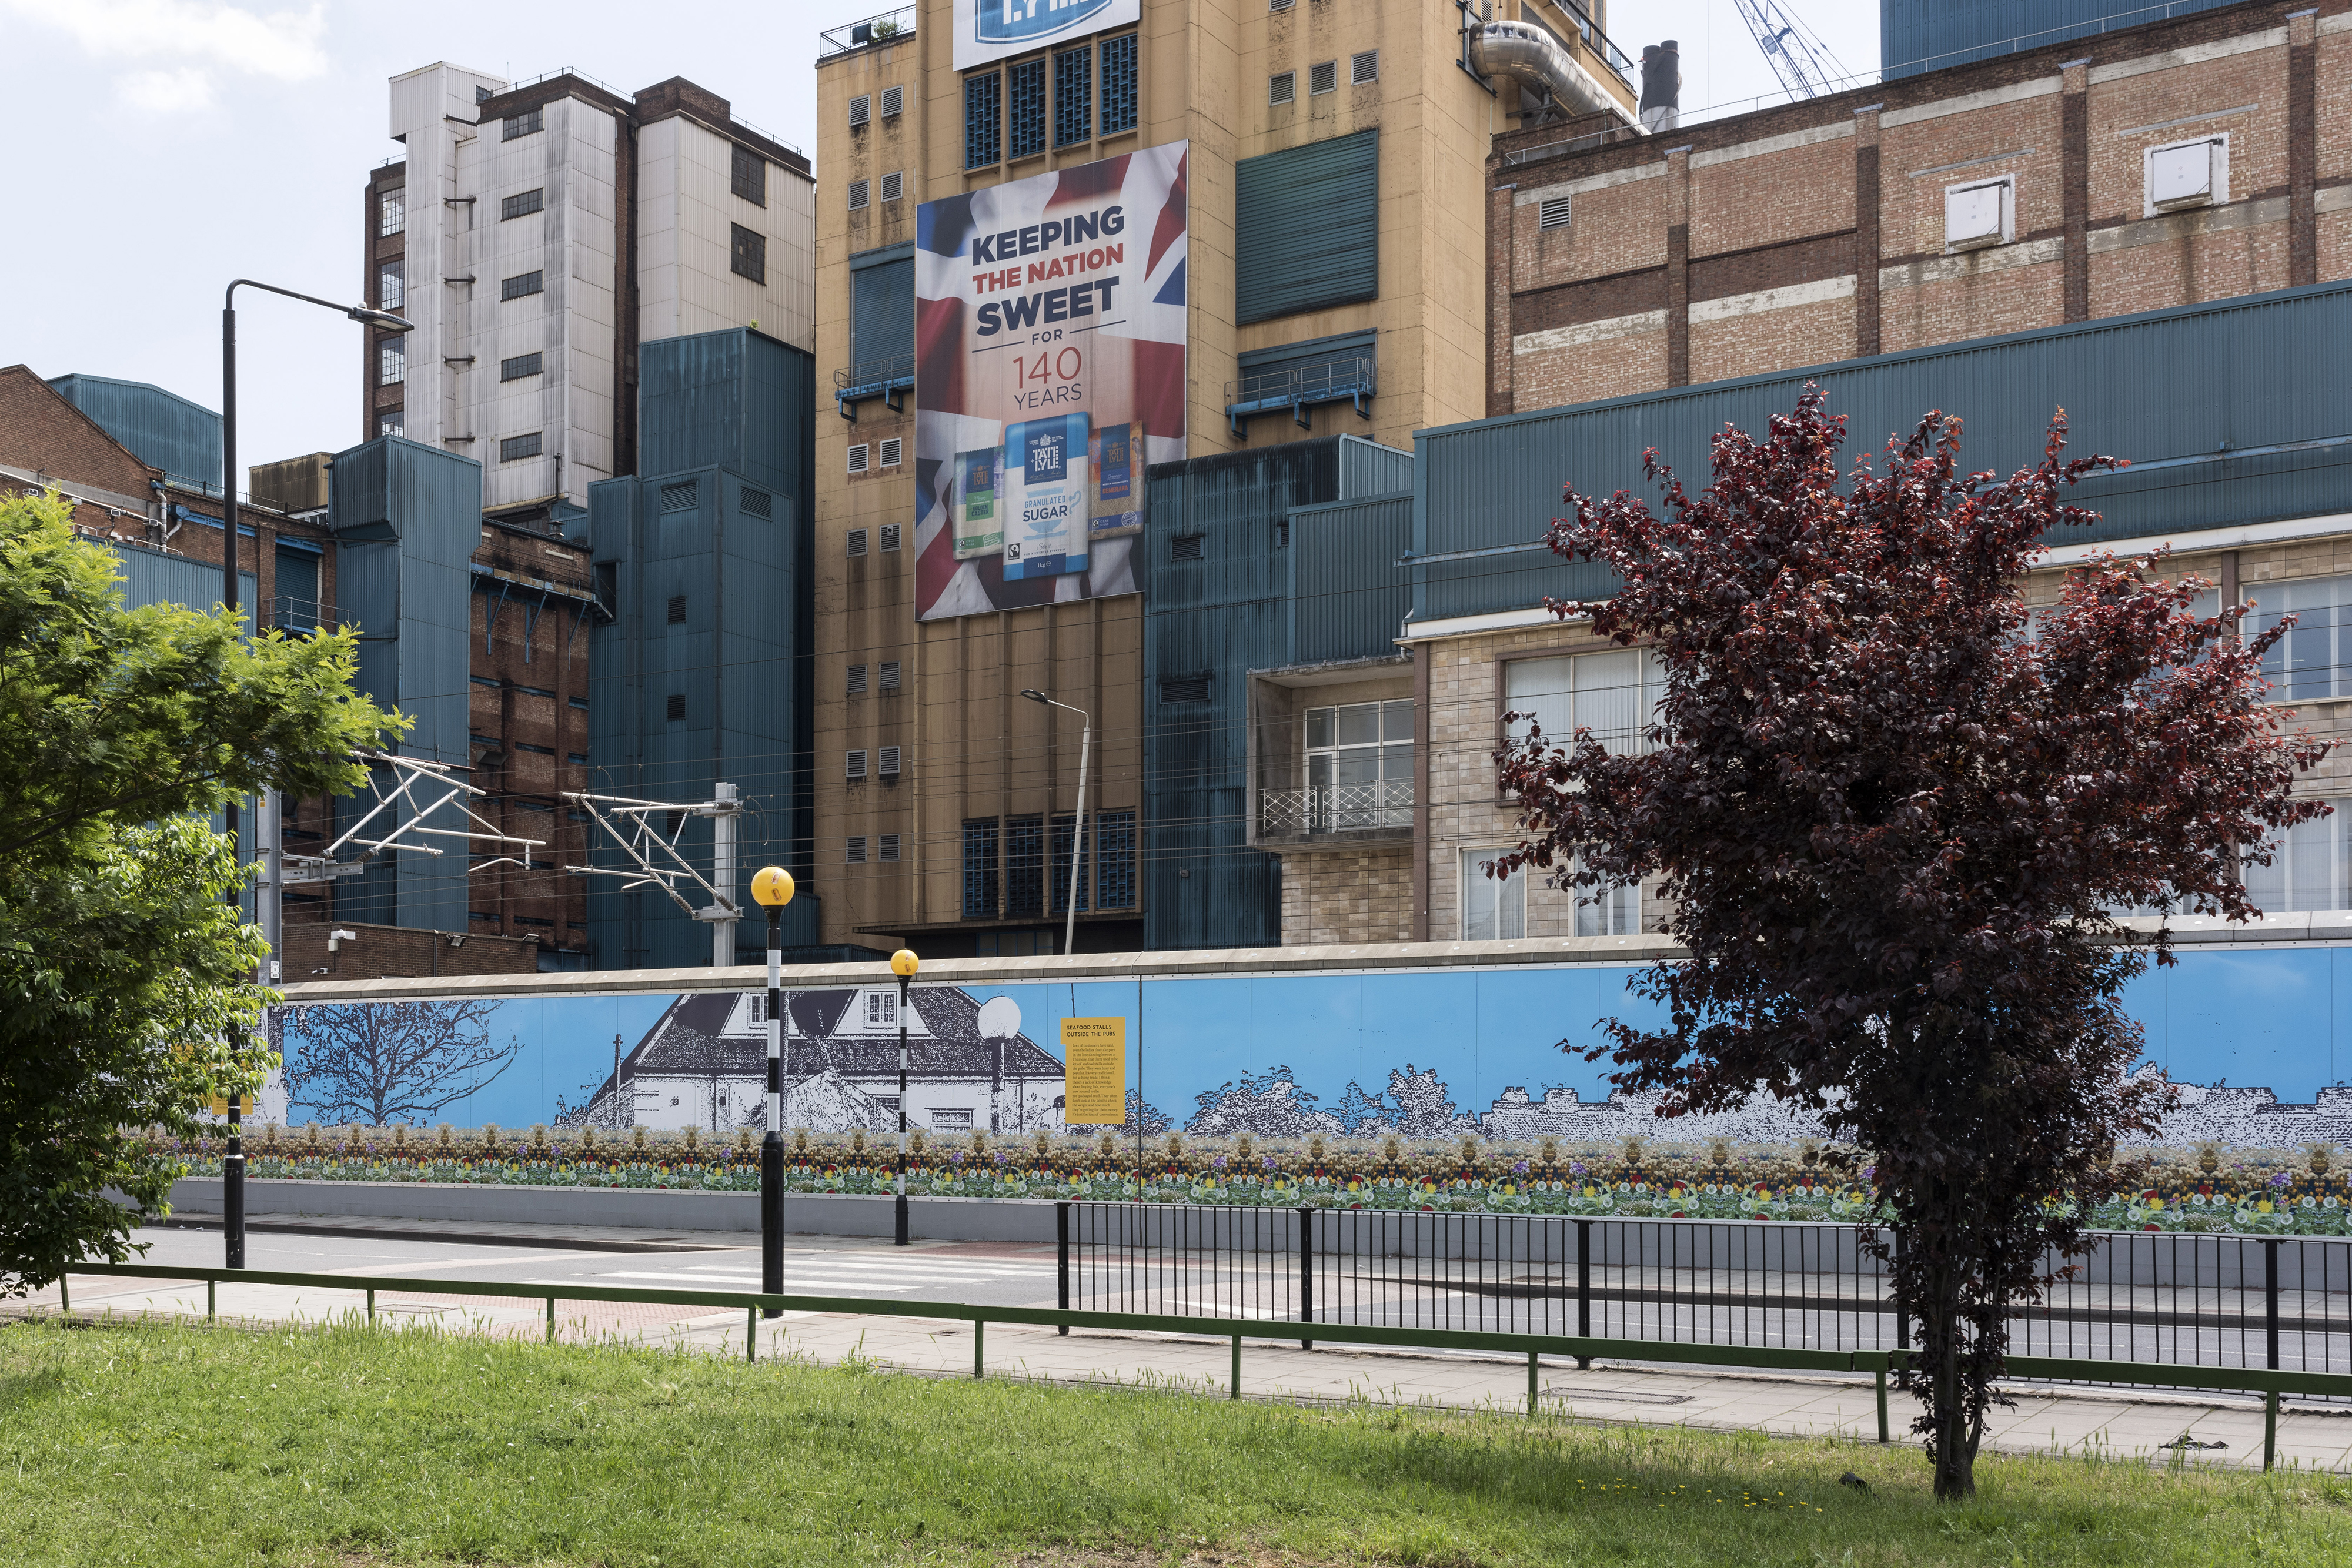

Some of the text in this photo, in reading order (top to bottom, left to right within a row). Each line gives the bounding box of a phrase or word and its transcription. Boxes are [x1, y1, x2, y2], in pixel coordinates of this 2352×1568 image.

[973, 206, 1124, 266] KEEPING
[973, 243, 1124, 295] THE NATION
[976, 275, 1120, 336] SWEET
[1032, 329, 1063, 345] FOR
[1013, 346, 1082, 389] 140
[1014, 383, 1082, 410] YEARS
[1033, 446, 1058, 460] TATE
[1035, 457, 1058, 472] LYLE
[973, 470, 988, 479] TATE
[974, 477, 988, 486] LYLE
[1102, 484, 1128, 494] DEMERARA
[1024, 495, 1066, 509] GRANULATED
[1023, 505, 1068, 522] SUGAR
